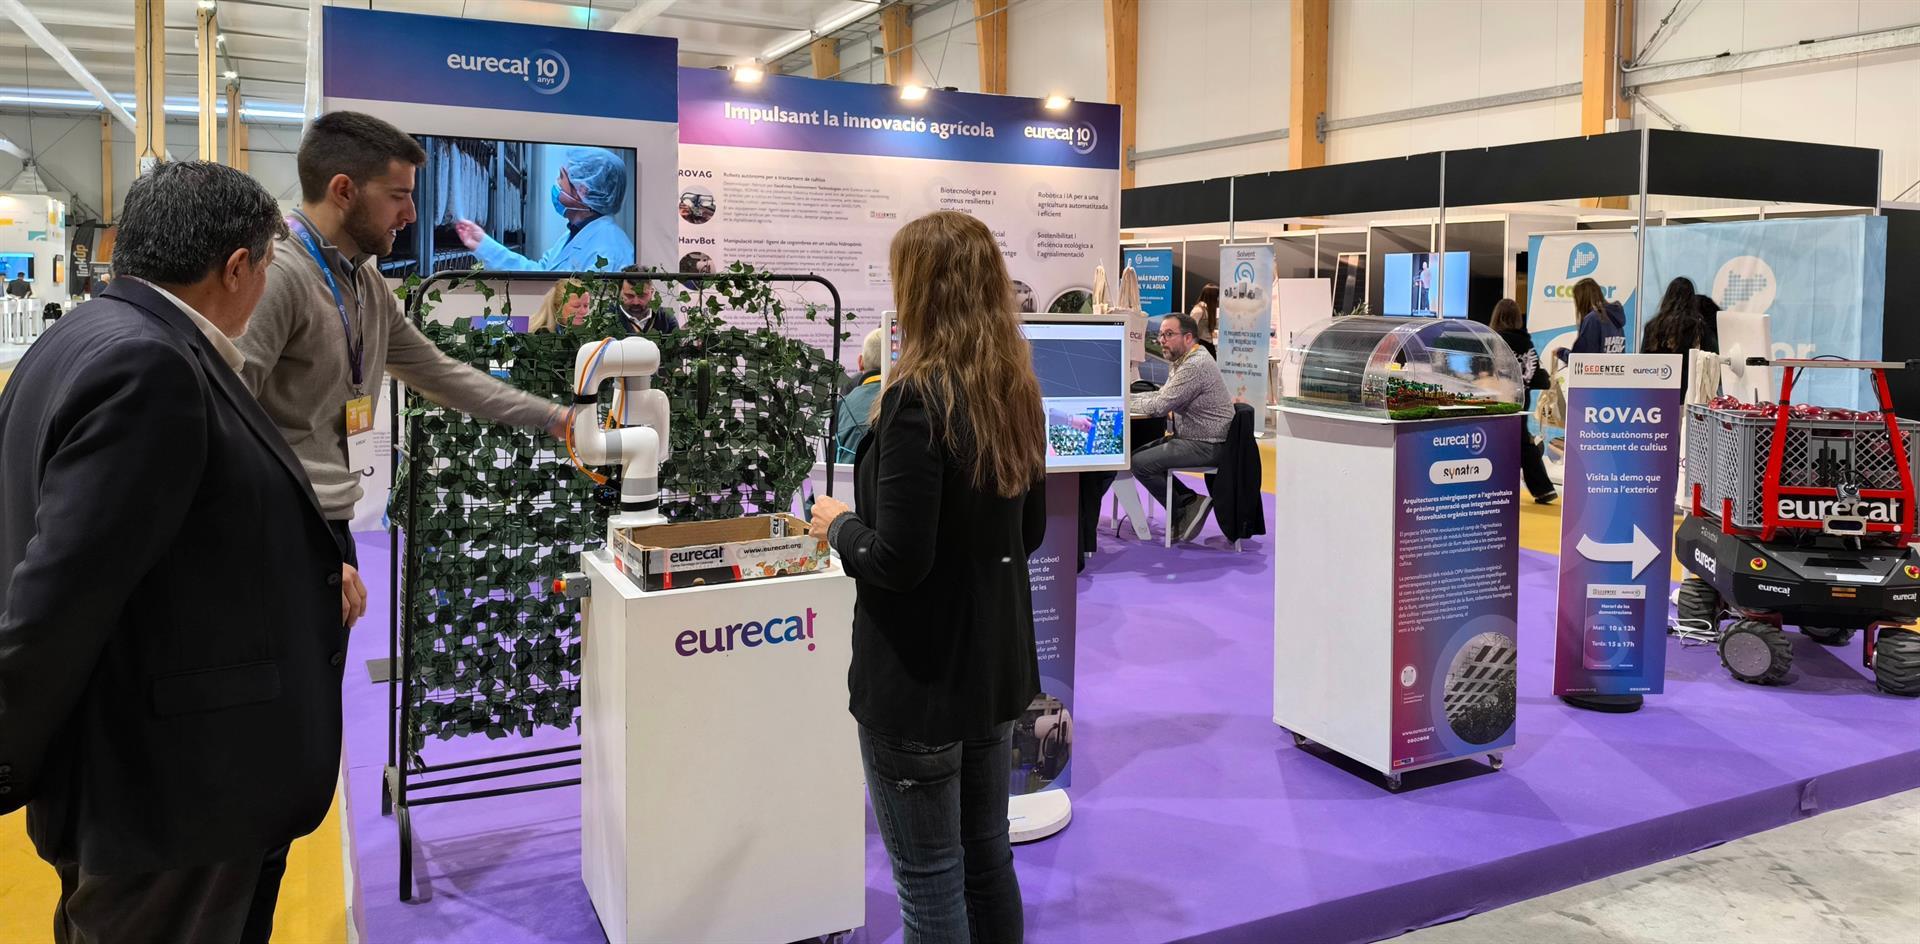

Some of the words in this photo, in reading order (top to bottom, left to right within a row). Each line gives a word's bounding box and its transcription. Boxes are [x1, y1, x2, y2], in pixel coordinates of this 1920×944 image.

[447, 54, 530, 82] eurecat
[536, 58, 558, 77] 10
[537, 76, 554, 85] anys
[724, 102, 819, 126] Impulsant
[824, 110, 839, 127] la
[843, 112, 926, 132] innovació
[930, 117, 994, 140] agrícola
[1024, 125, 1073, 145] eurecat
[1076, 128, 1090, 143] 10
[678, 170, 713, 178] ROVAG
[940, 187, 980, 196] Biotecnologia
[679, 237, 715, 245] HarvBot
[1037, 250, 1084, 258] l'agroalimentació
[1633, 368, 1659, 376] eurecat
[1585, 407, 1661, 423] ROVAG
[1433, 433, 1470, 448] eurecat
[1472, 433, 1481, 444] 10
[1580, 430, 1609, 439] Robots
[1611, 430, 1653, 439] autònoms
[1655, 432, 1668, 442] per
[1444, 464, 1479, 479] synatra
[1645, 475, 1661, 483] que
[1403, 497, 1439, 505] Arquitectures
[1481, 490, 1512, 499] l'agrivoltaica
[1436, 504, 1460, 512] generació
[1778, 498, 1901, 532] eurecat
[670, 546, 724, 563] eurecat
[744, 543, 802, 554] www.eurecat.org
[1694, 548, 1716, 582] eurecat
[1758, 584, 1790, 596] eurecat
[1893, 593, 1917, 602] eurecat
[675, 608, 817, 656] eurecat
